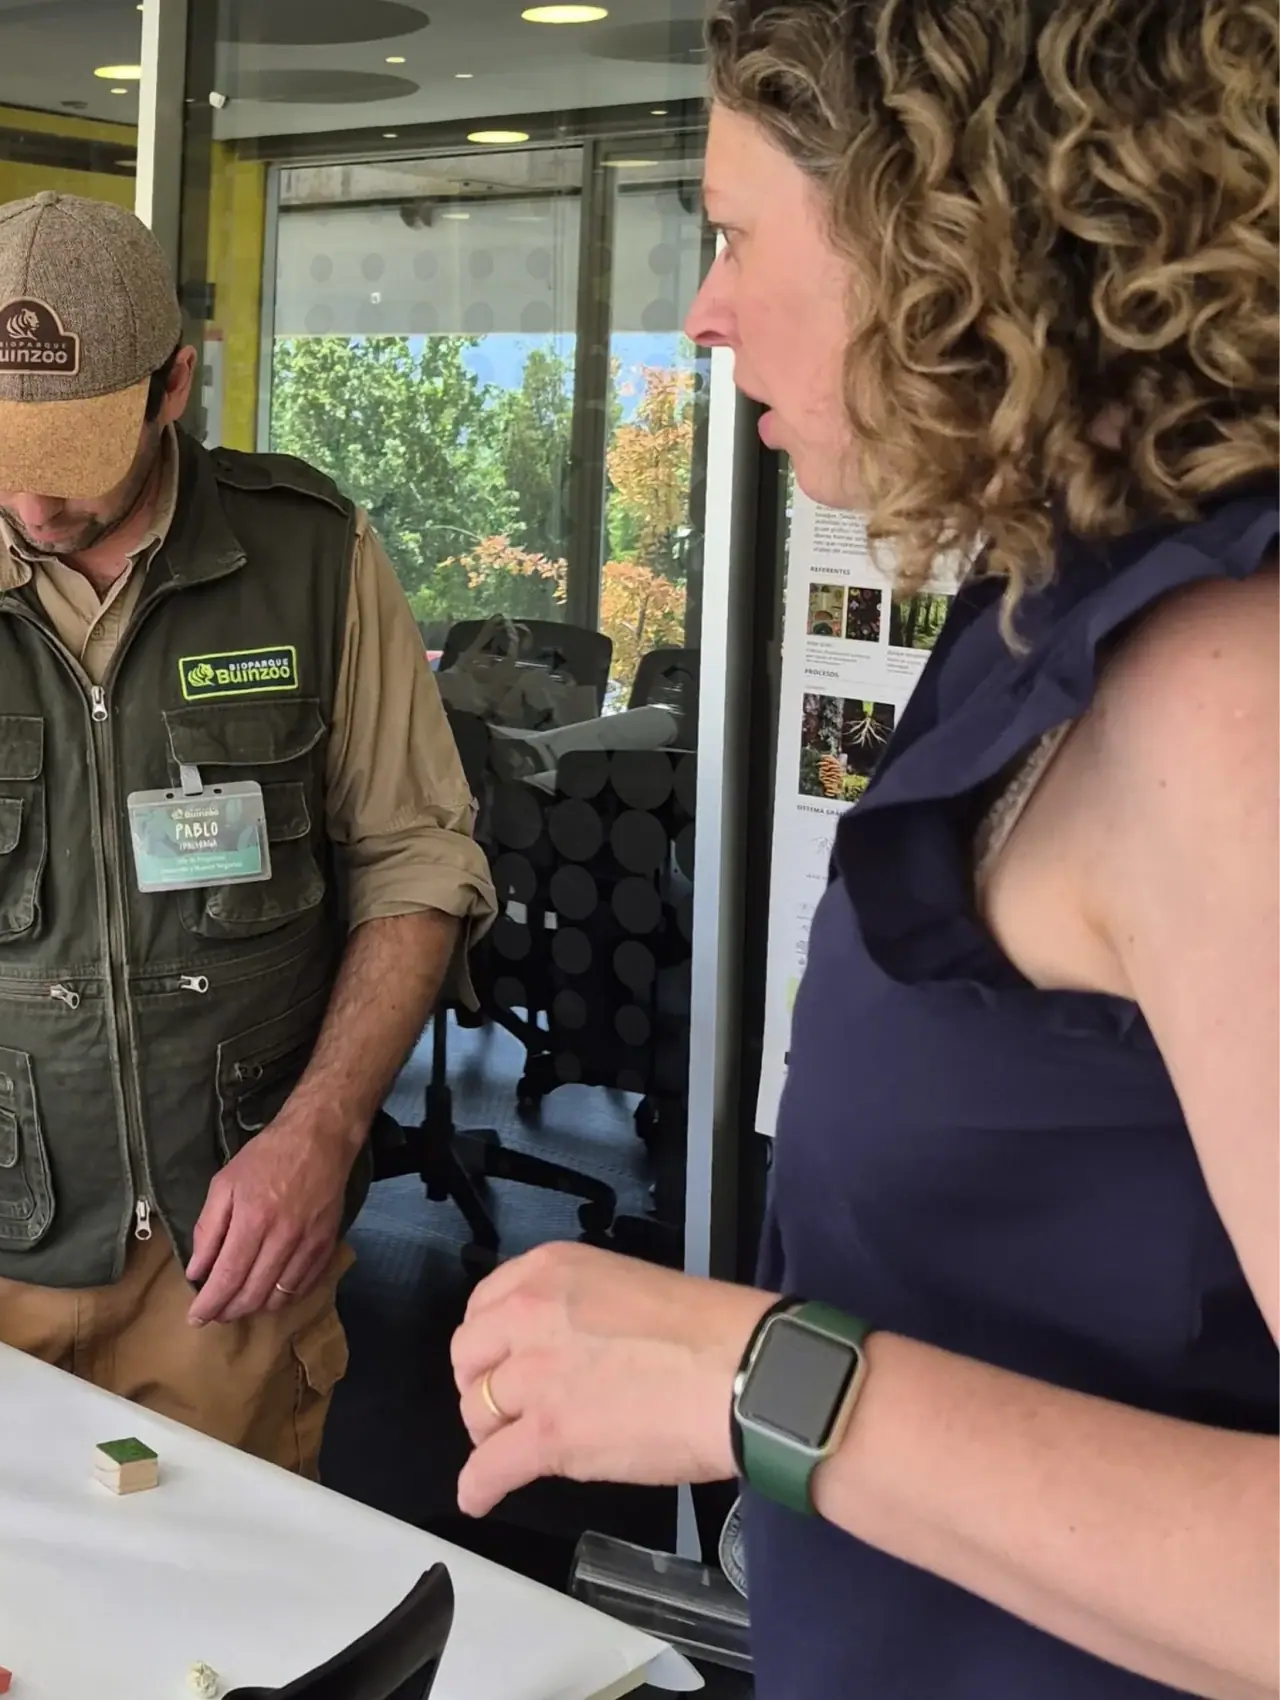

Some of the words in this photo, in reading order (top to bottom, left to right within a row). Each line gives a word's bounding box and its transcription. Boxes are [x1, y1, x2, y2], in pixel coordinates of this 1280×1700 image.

[0, 341, 67, 350] BIOPARQUE
[810, 566, 851, 576] REFERENTES
[228, 658, 289, 671] BIOPARQUE
[215, 666, 291, 685] Buinzoo
[804, 668, 840, 678] PROCESOS
[796, 804, 825, 814] SISTEMA
[175, 821, 218, 840] PABLO
